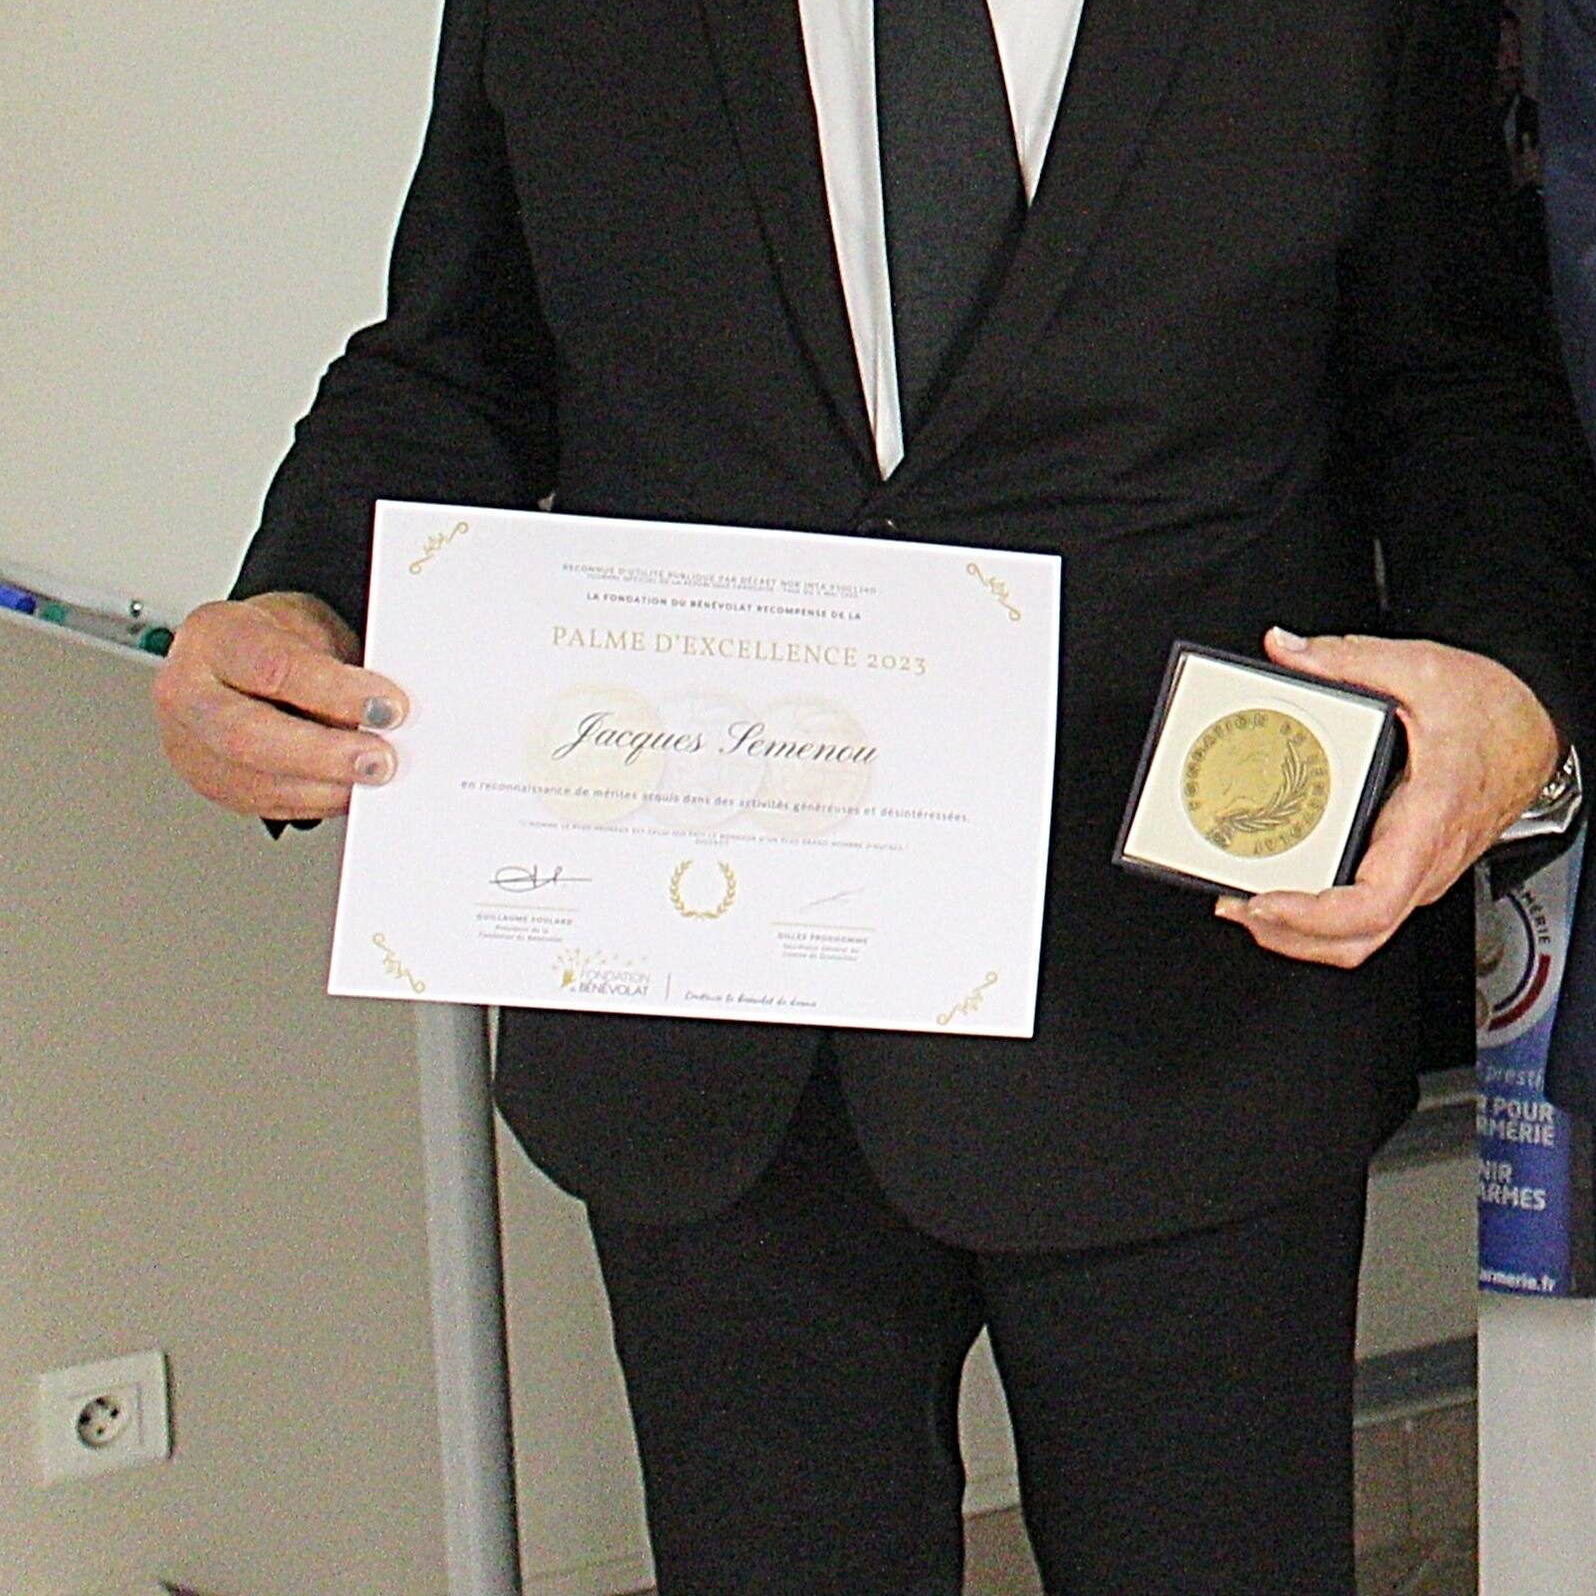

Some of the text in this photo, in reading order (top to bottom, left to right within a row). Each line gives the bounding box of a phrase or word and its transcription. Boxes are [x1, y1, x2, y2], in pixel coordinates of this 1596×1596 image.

[552, 625, 928, 676] PALME D'EXCELLENCE 2023
[552, 711, 706, 767] Jacques
[460, 780, 476, 790] en
[479, 781, 571, 796] reconnaissance
[574, 785, 590, 796] de
[682, 794, 710, 805] dans
[714, 795, 734, 806] des
[864, 806, 877, 816] et
